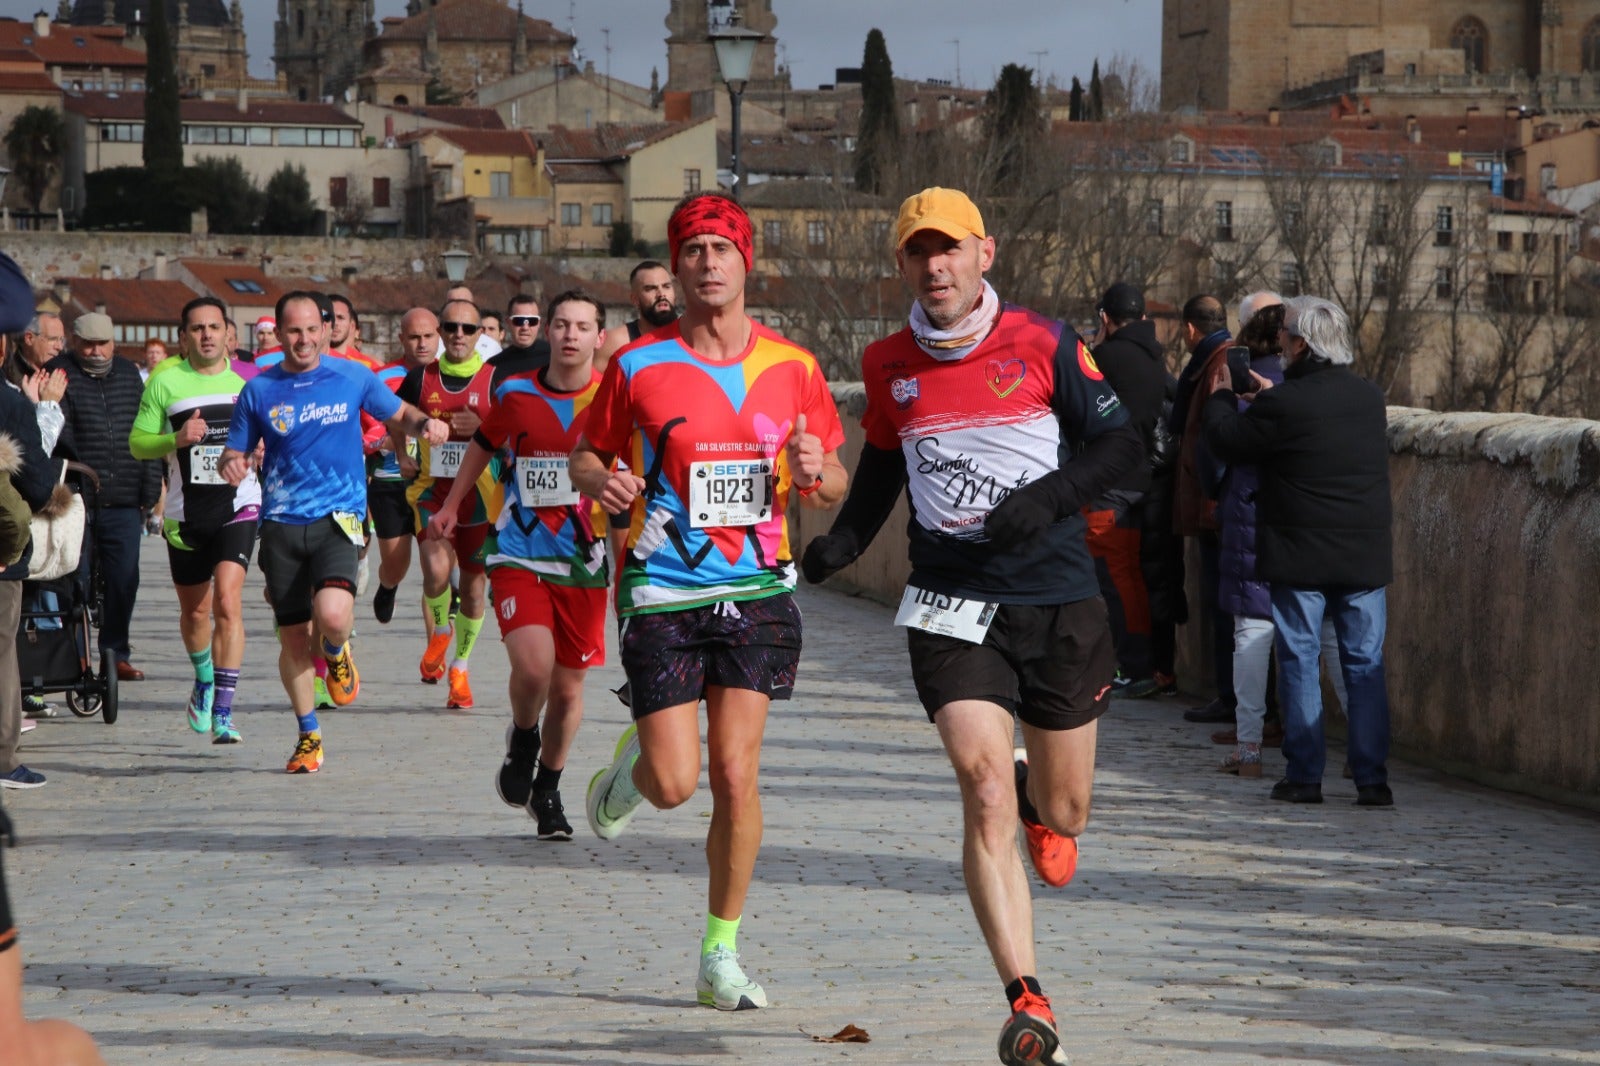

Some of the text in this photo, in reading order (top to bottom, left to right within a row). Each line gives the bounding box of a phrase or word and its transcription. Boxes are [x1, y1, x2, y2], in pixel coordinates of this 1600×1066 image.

[299, 403, 348, 424] CABRAS
[695, 442, 709, 452] SAN
[709, 442, 743, 452] SILVESTRE
[915, 436, 979, 474] Simón
[526, 470, 558, 490] 643
[706, 478, 754, 505] 1923
